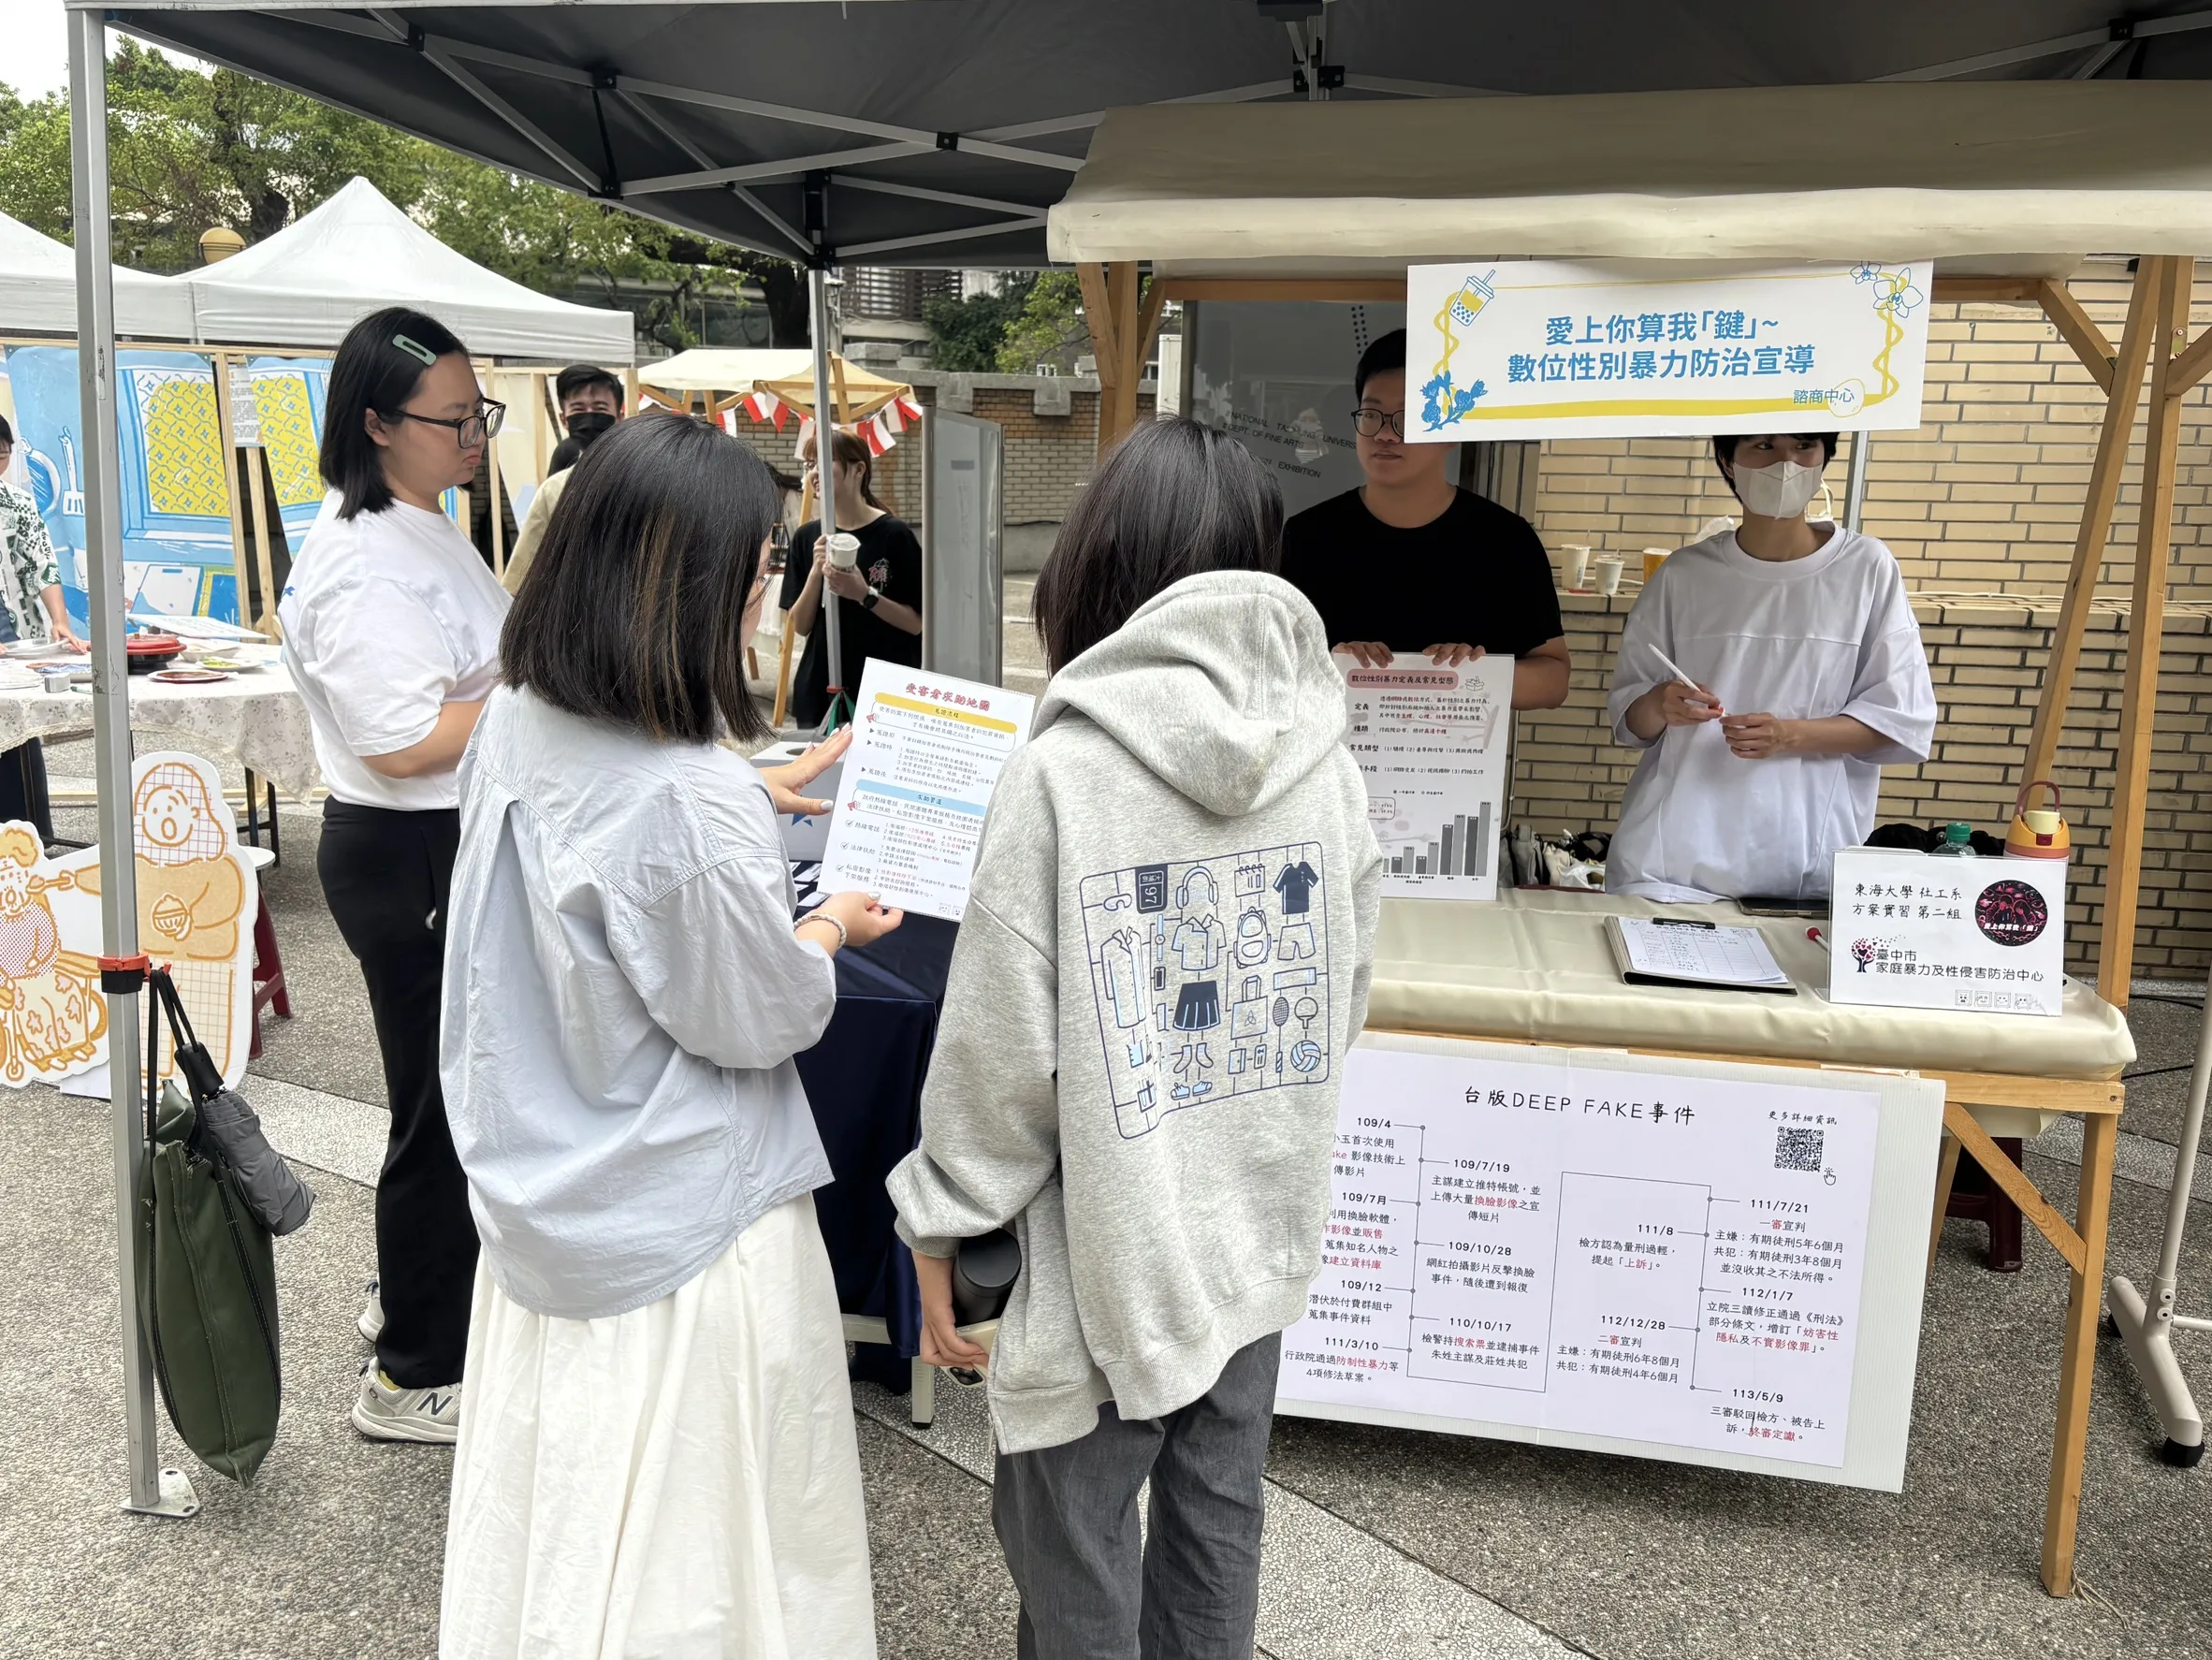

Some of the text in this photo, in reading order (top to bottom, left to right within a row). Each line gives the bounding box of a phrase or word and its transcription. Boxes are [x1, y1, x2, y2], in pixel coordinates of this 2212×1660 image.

[1507, 344, 1815, 384] 數位性別暴力防治宣導
[1792, 388, 1855, 405] 諮商中心
[1231, 412, 1269, 428] NATIONAL
[1277, 461, 1321, 478] EXHIBITION
[905, 683, 991, 711] 受害者求助地圖
[1349, 744, 1379, 752] 常見類型
[1144, 886, 1157, 904] 97
[1854, 882, 1962, 900] 東海大學 社工系
[1852, 902, 1962, 920] 方案實習 第二組
[1876, 949, 1916, 962] 臺中市
[1876, 962, 2045, 982] 家庭暴力及性侵害防治中心
[1464, 1085, 1695, 1126] 台版DEEP FAKE事件
[1357, 1117, 1391, 1129] 109/4
[1768, 1111, 1838, 1126] 更多詳細資訊
[1351, 1151, 1405, 1165] 影像技術上
[1453, 1159, 1511, 1172] 109/7/19
[1333, 1164, 1364, 1177] 傳影片
[1342, 1192, 1387, 1205] 109/7月
[1431, 1191, 1540, 1212] 上傳大量換臉影像之宣
[1751, 1199, 1809, 1213] 111/7/21
[1467, 1210, 1500, 1223] 傳短片
[1637, 1224, 1674, 1236] 111/8
[1759, 1219, 1806, 1233] 一審宣判
[1325, 1239, 1398, 1256] 蒐集知名人物之
[1448, 1241, 1512, 1256] 109/10/28
[1714, 1230, 1844, 1253] 主嫌：有期徒刑5年6個月
[1591, 1254, 1661, 1271] 提起「上訴」。
[1713, 1245, 1842, 1270] 共犯：有期徒刑3年8個月
[1426, 1258, 1535, 1278] 網紅拍攝影片反擊換臉
[1341, 1279, 1382, 1292] 109/12
[1741, 1287, 1794, 1302] 112/1/7
[1308, 1309, 1372, 1325] 蒐集事件資料
[1449, 1318, 1512, 1332] 110/10/17
[1600, 1314, 1666, 1331] 112/12/28
[1324, 1337, 1379, 1351] 111/3/10
[1421, 1333, 1540, 1355] 檢警持搜索票並逮捕事件
[1597, 1333, 1643, 1348] 二審宣判
[1285, 1350, 1399, 1371] 行政院通過防制性暴力等
[1431, 1350, 1528, 1370] 朱姓主謀及莊姓共犯
[1557, 1344, 1681, 1369] 主嫌：有期徒刑6年8個月
[1306, 1368, 1374, 1383] 4項修法草案。
[1556, 1359, 1679, 1384] 共犯：有期徒刑4年6個月
[1733, 1388, 1783, 1403] 113/5/9
